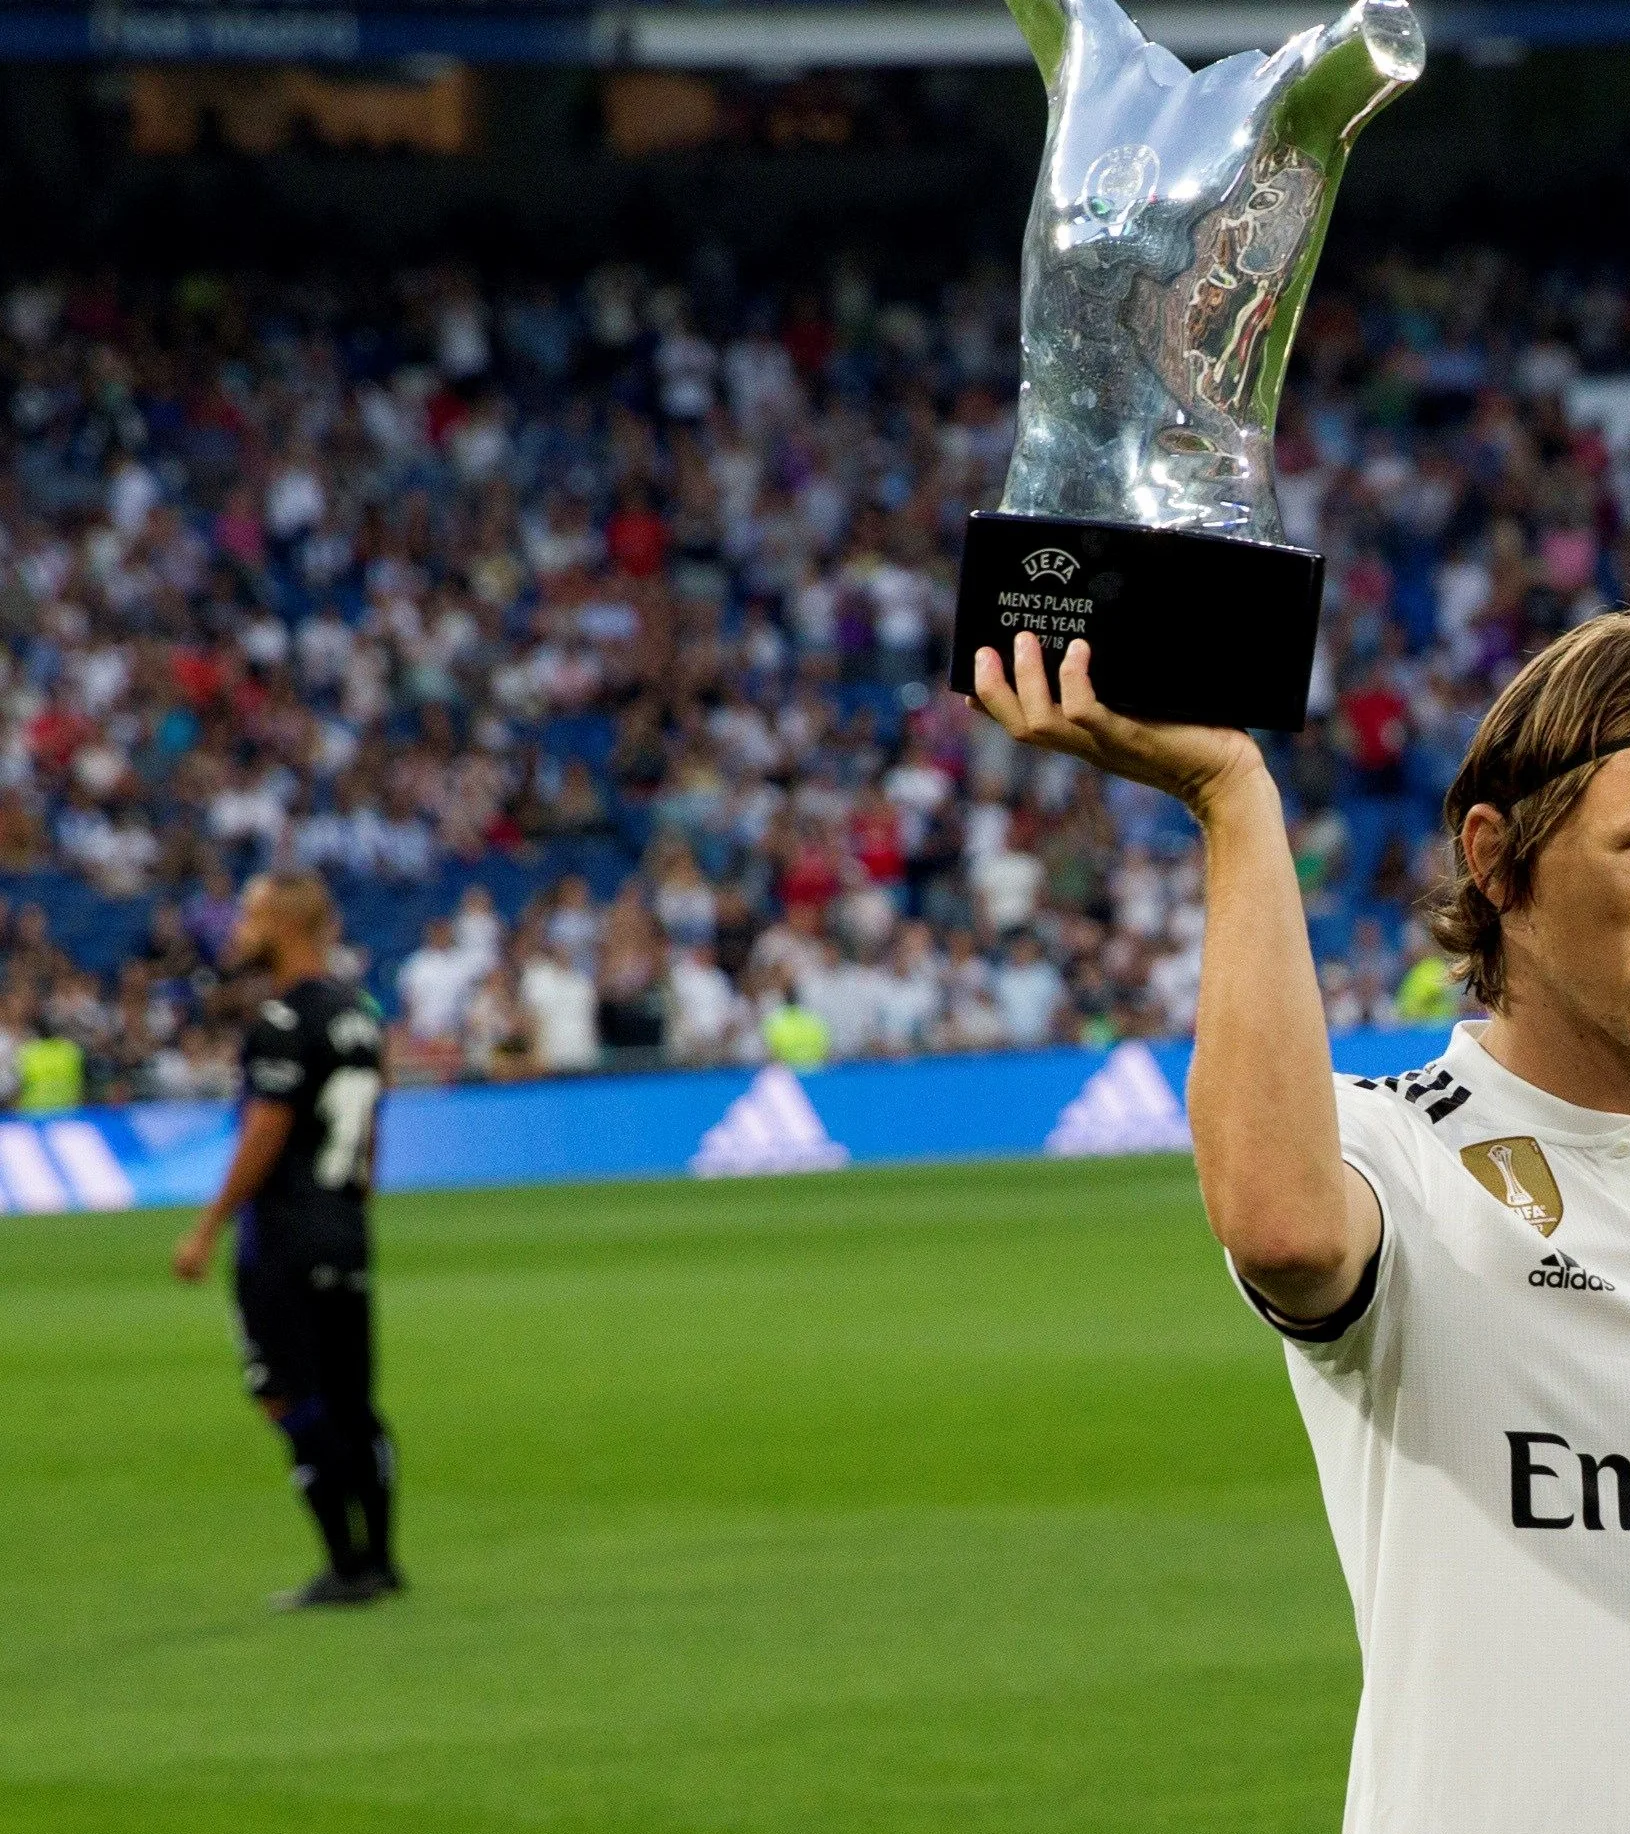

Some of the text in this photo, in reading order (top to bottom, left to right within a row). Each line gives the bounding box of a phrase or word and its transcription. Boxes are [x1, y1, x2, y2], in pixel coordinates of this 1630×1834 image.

[1024, 553, 1075, 580] UEFA
[998, 591, 1094, 614] MEN'S PLAYER
[1001, 611, 1086, 633] OF THE YEAR
[1528, 1266, 1615, 1292] adidas
